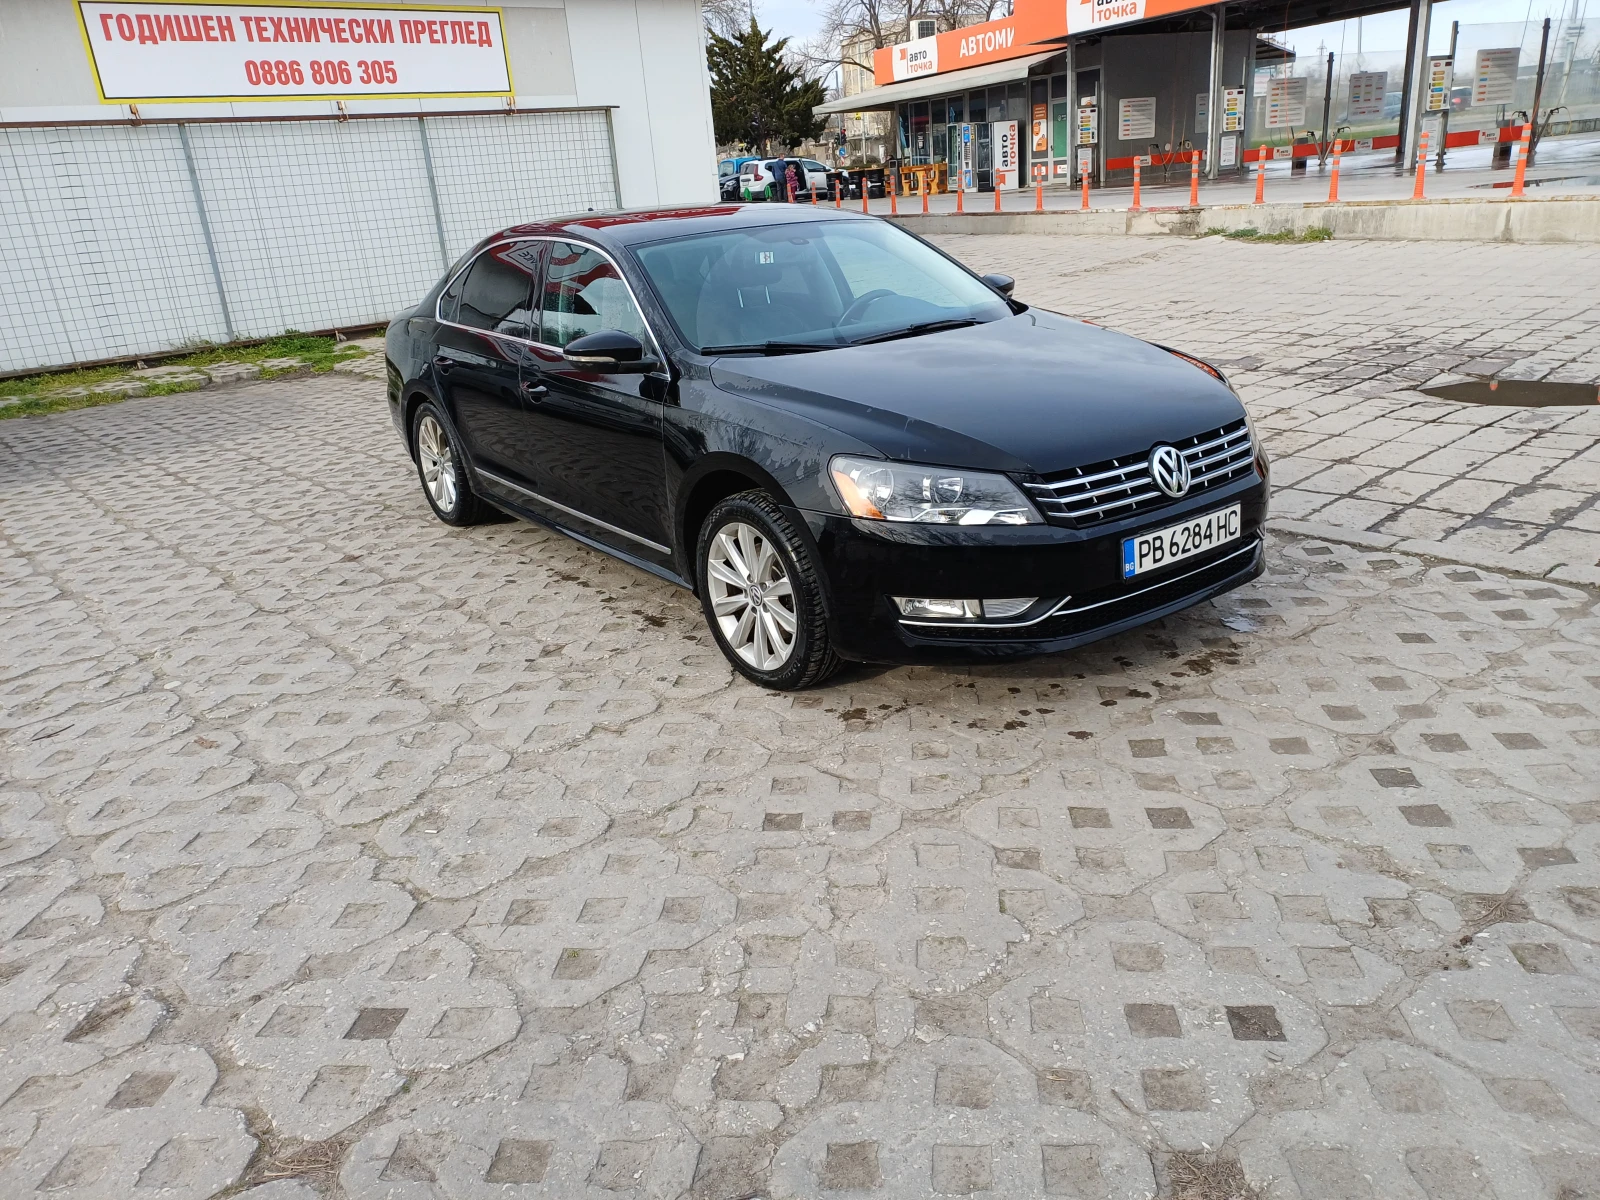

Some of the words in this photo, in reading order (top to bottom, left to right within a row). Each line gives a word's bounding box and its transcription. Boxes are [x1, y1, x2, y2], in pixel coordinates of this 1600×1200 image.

[1096, 2, 1137, 22] точка
[99, 13, 237, 45] ГОДИШЕН
[239, 16, 395, 44] ТЕХНИЧЕСКИ
[399, 19, 493, 48] ПРЕГЛЕД
[909, 49, 928, 63] авто
[909, 60, 933, 74] точка
[244, 59, 305, 86] 0886
[309, 59, 353, 86] 806
[357, 60, 398, 85] 305
[1001, 134, 1009, 168] авто
[1009, 124, 1017, 167] точка
[1138, 535, 1165, 569] PB
[1169, 518, 1213, 558] 6284
[1216, 509, 1238, 542] HC
[1125, 561, 1135, 573] BG
